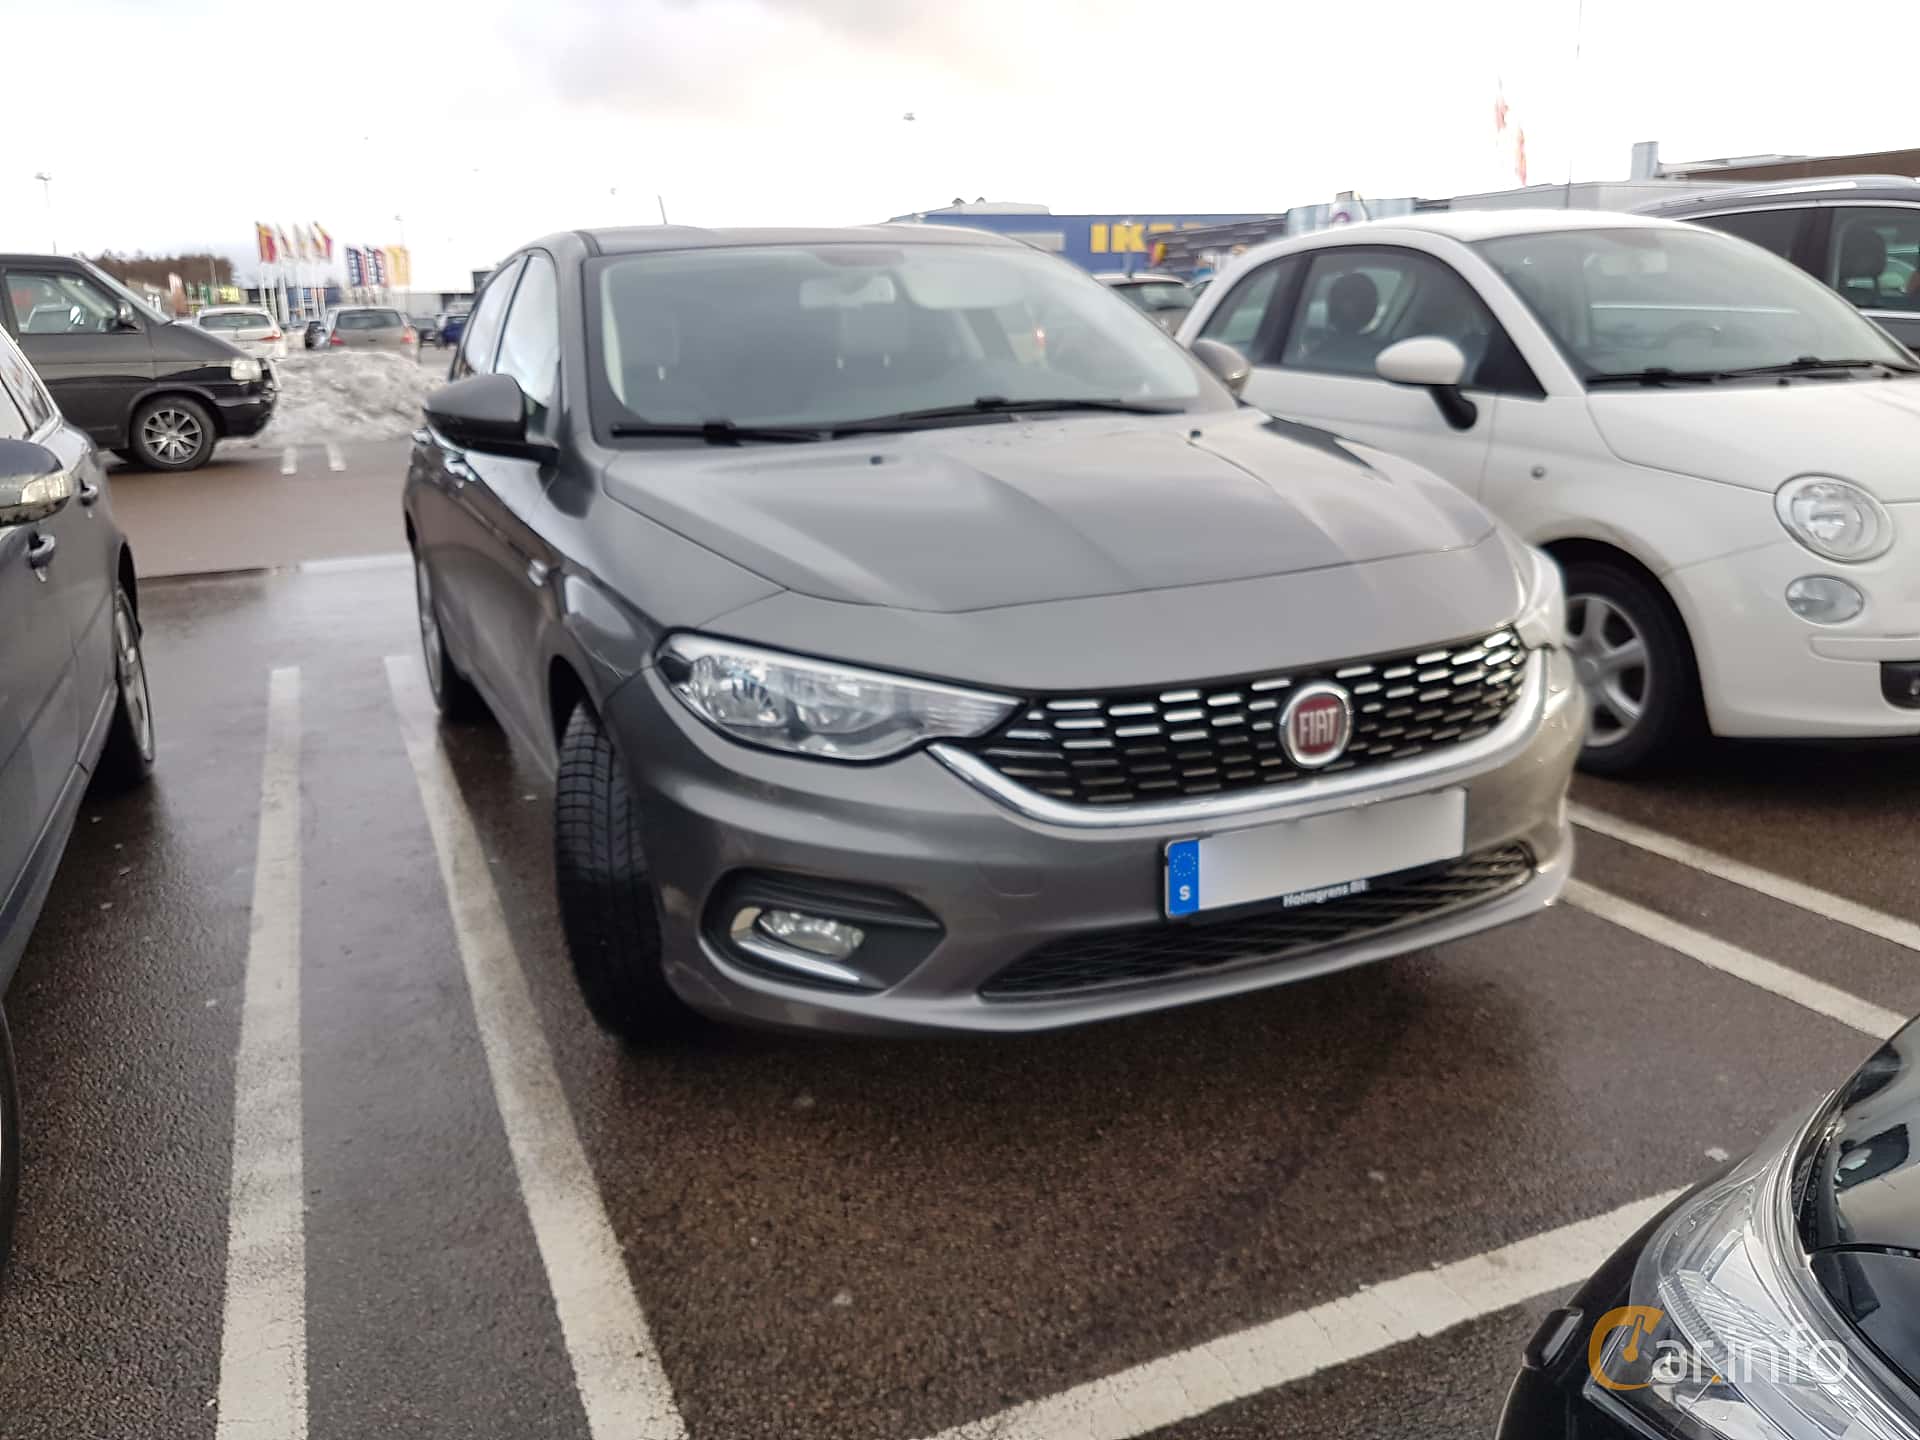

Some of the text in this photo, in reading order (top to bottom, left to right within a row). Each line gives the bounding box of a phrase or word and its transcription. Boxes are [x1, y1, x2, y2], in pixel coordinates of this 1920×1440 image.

[1090, 222, 1190, 254] IK
[1298, 706, 1337, 746] FIAT
[1179, 885, 1190, 901] S
[1283, 884, 1348, 908] Holmgrens
